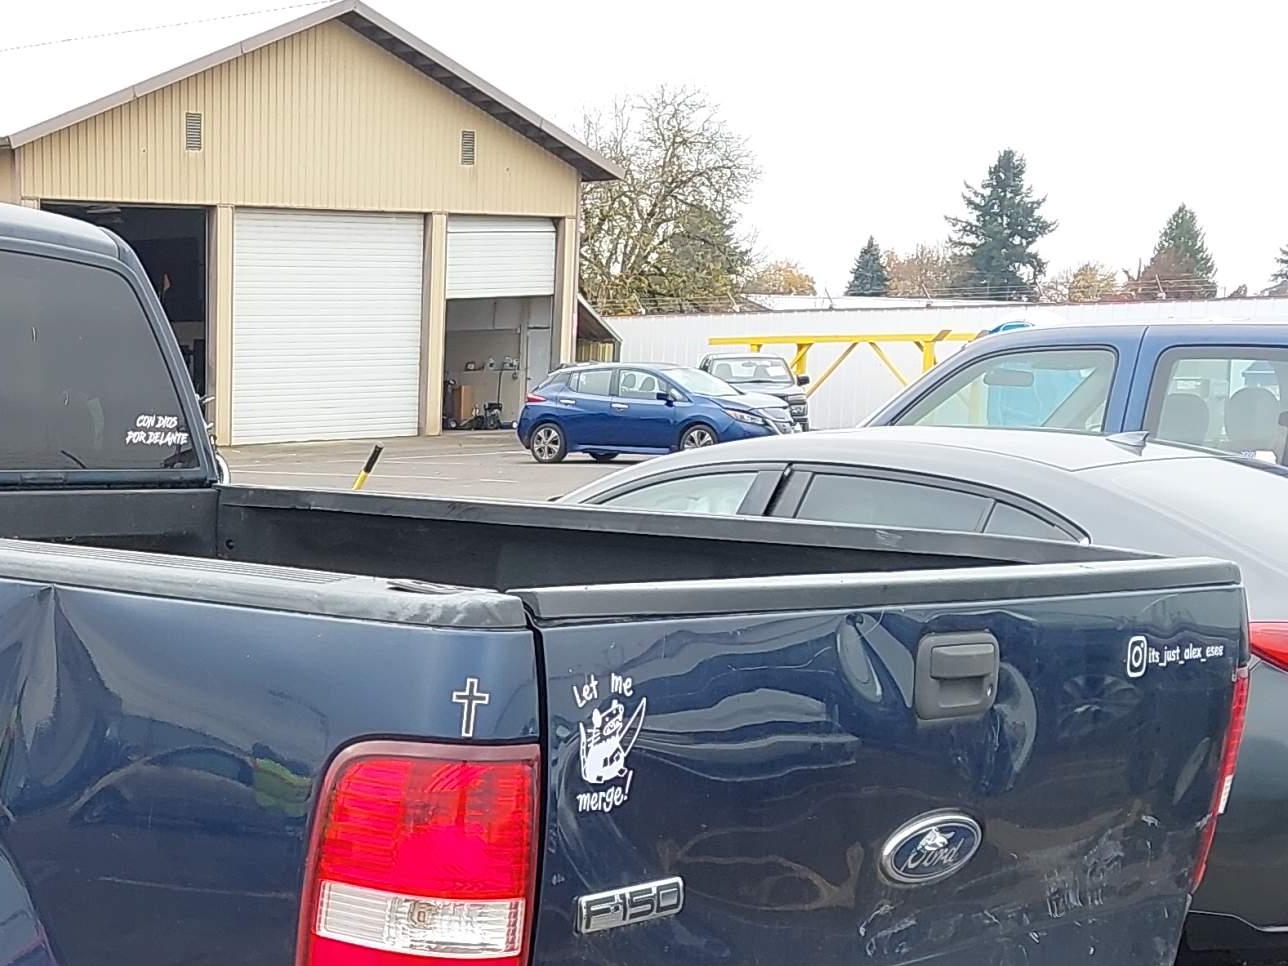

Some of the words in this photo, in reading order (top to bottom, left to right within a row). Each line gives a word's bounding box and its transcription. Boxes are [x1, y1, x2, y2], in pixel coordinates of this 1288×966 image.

[136, 414, 156, 429] CON
[155, 415, 178, 428] DIOS
[126, 430, 147, 444] POR
[146, 431, 189, 446] DELANTE
[573, 674, 599, 708] Let
[611, 672, 633, 696] me
[576, 770, 633, 812] merge!
